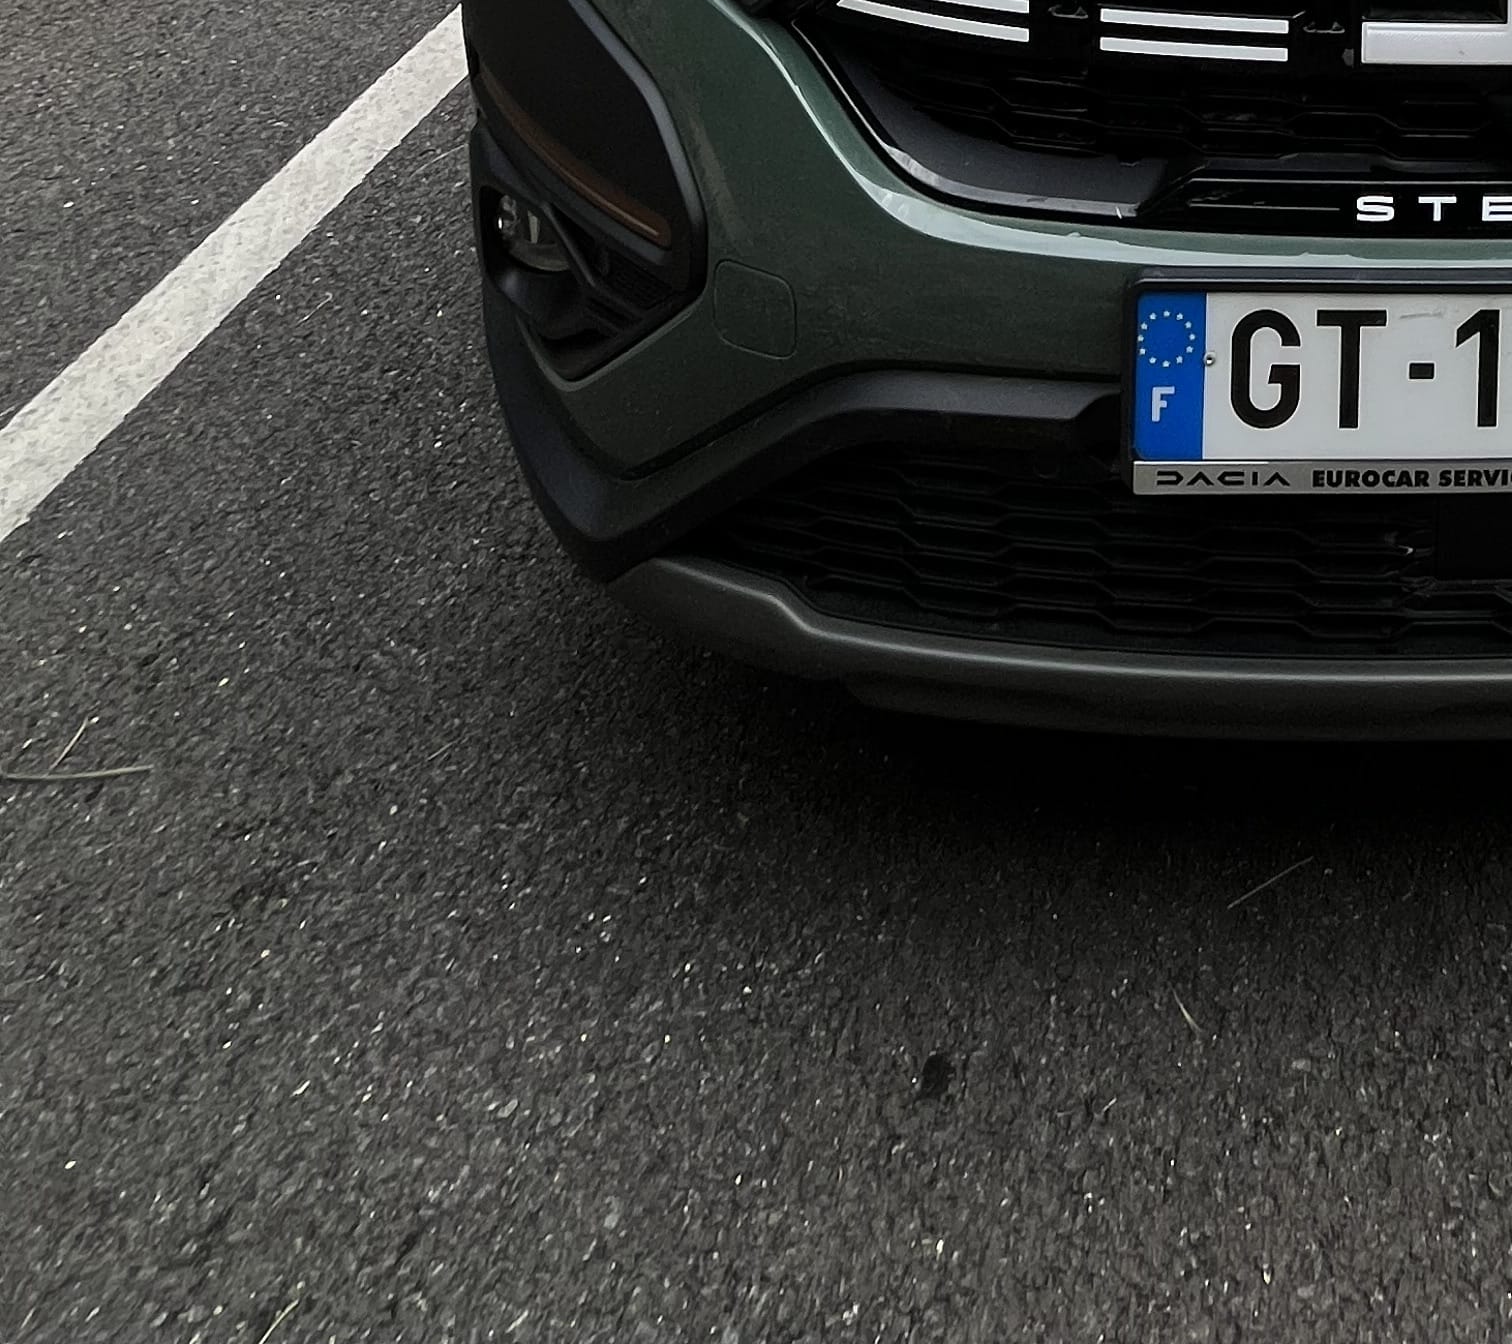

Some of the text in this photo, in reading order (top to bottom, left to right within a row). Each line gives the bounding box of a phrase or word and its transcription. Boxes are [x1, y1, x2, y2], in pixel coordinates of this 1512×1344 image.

[1151, 385, 1176, 422] F
[1157, 470, 1291, 487] DACIA
[1312, 469, 1430, 488] EUROCAR
